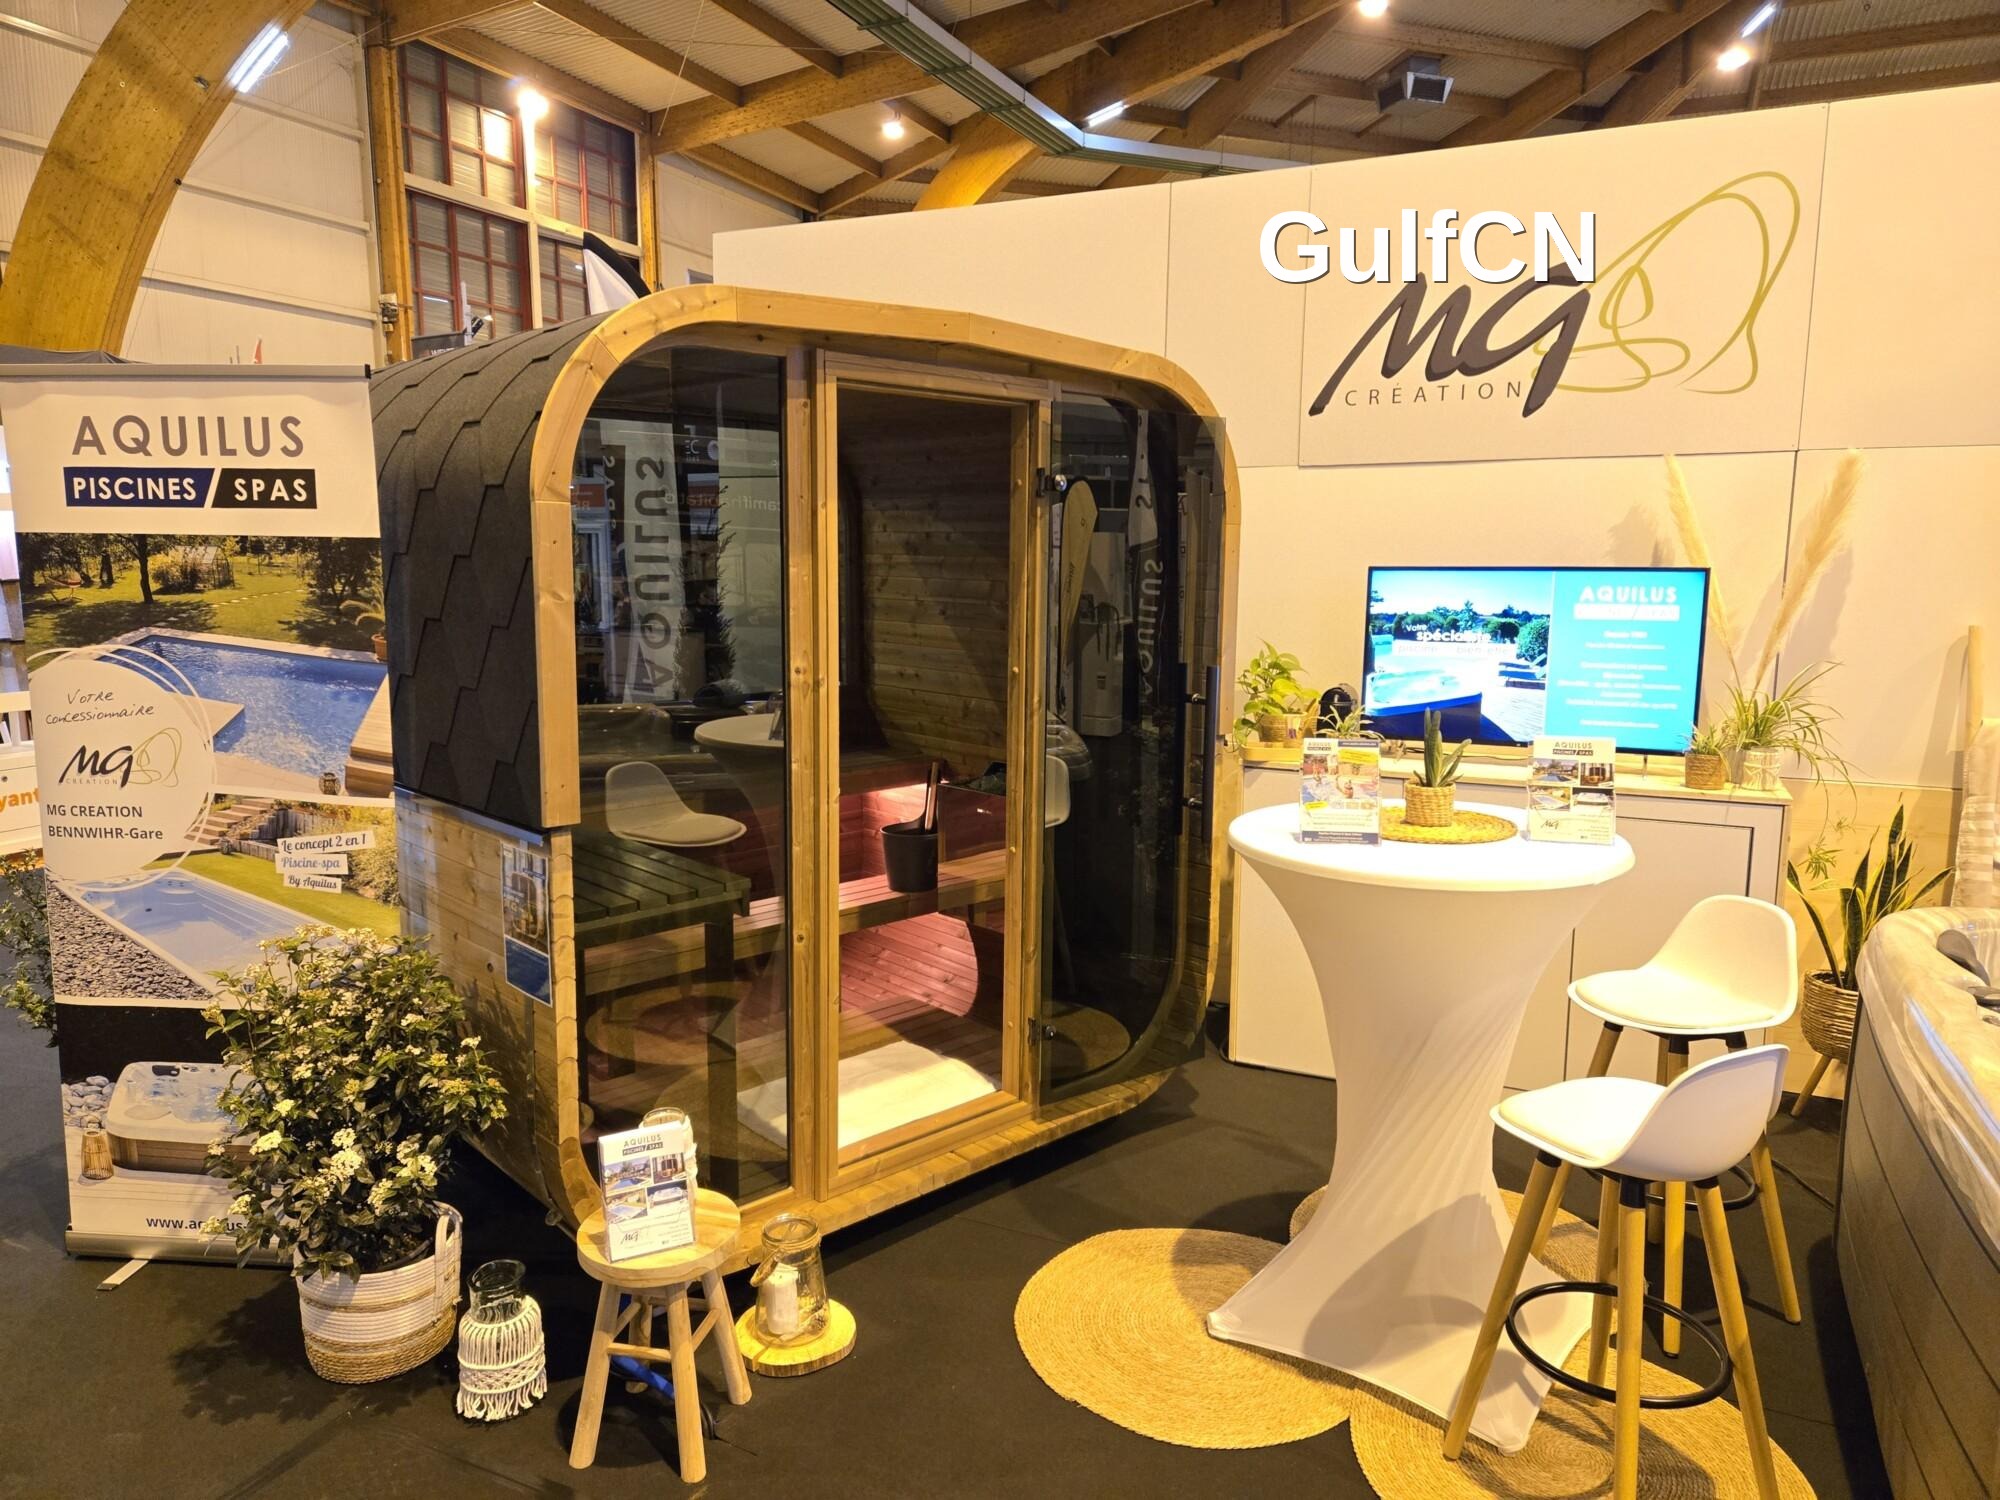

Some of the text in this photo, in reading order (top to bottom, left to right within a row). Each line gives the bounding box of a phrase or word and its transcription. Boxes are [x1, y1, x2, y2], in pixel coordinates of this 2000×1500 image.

[1345, 381, 1522, 406] CRÉATION
[71, 414, 305, 458] AQUILUS
[72, 476, 308, 502] PISCINES SPAS
[1579, 585, 1678, 603] AQUILUS
[46, 804, 143, 818] MG CREATION
[48, 825, 164, 840] BENNWIHR-Gare
[281, 833, 366, 854] Le concept 2 en 1
[281, 856, 340, 871] Piscine-spa
[288, 874, 337, 889] By Aquilus
[623, 1133, 662, 1147] AQUILUS
